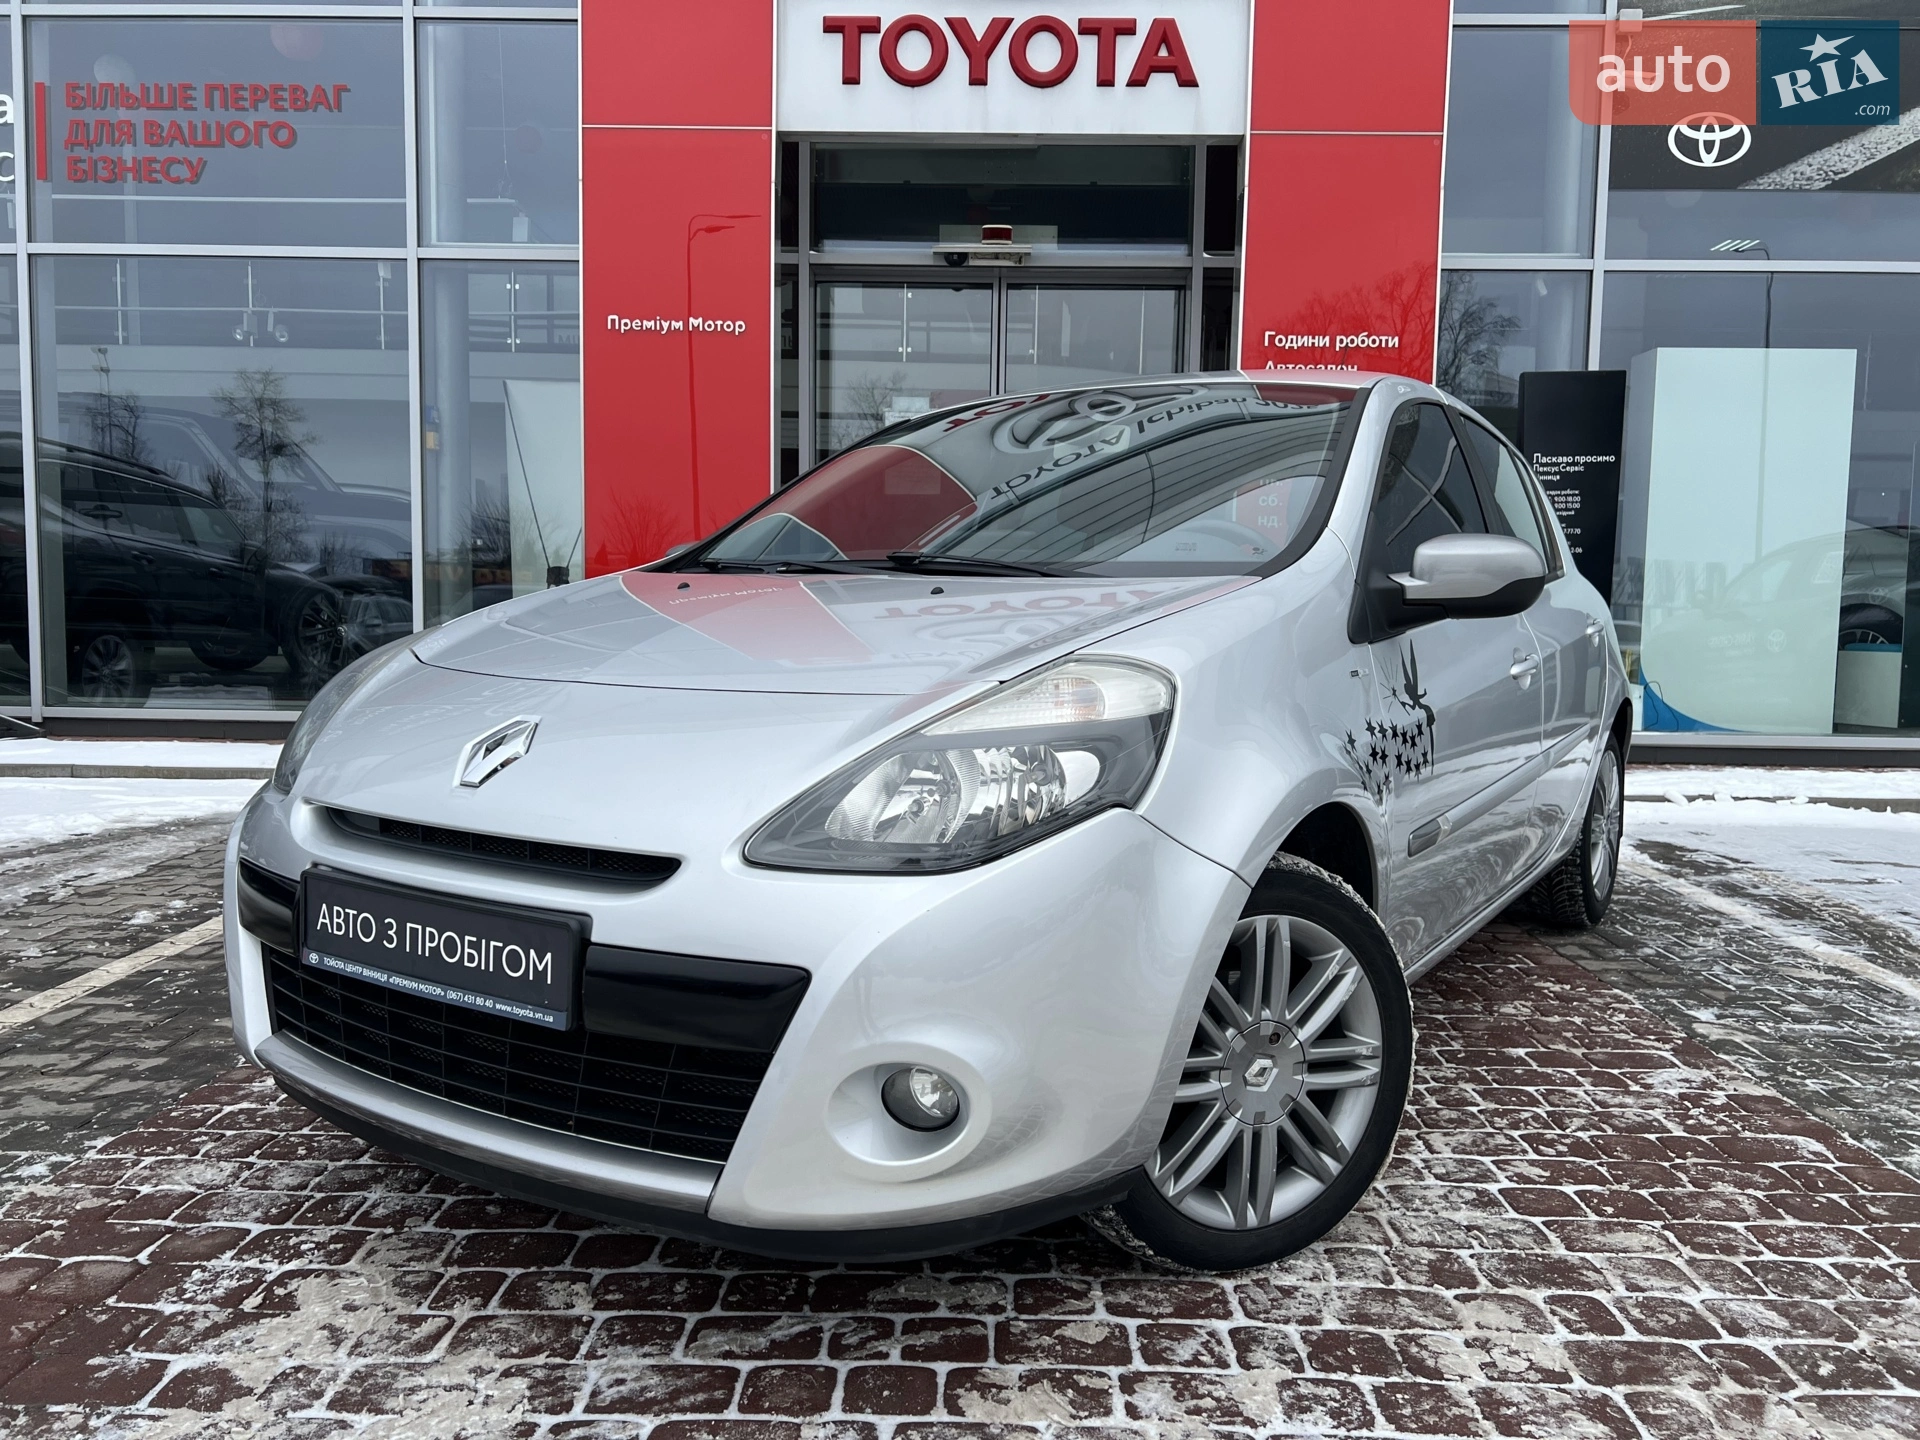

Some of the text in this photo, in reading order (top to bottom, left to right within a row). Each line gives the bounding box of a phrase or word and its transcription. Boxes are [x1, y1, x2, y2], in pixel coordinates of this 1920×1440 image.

[822, 14, 1200, 88] TOYOTA
[65, 82, 351, 111] БІЛЬШЕ ПЕРЕВАГ
[64, 118, 296, 150] ДЛЯ ВАШОГО
[66, 155, 205, 184] БІЗНЕСУ
[607, 315, 746, 335] Преміум Мотор
[1264, 331, 1400, 352] Години роботи
[1533, 453, 1616, 465] Ласкаво просимо
[316, 903, 377, 943] АВТО
[405, 922, 552, 985] ПРОБІГОМ
[323, 957, 554, 1023] ТОЙОТА ЦЕНТР ВІННИЦЯ «ПРЕМІУМ МОТОР» (067) 431 80 40 www.toyota.vn.ua
